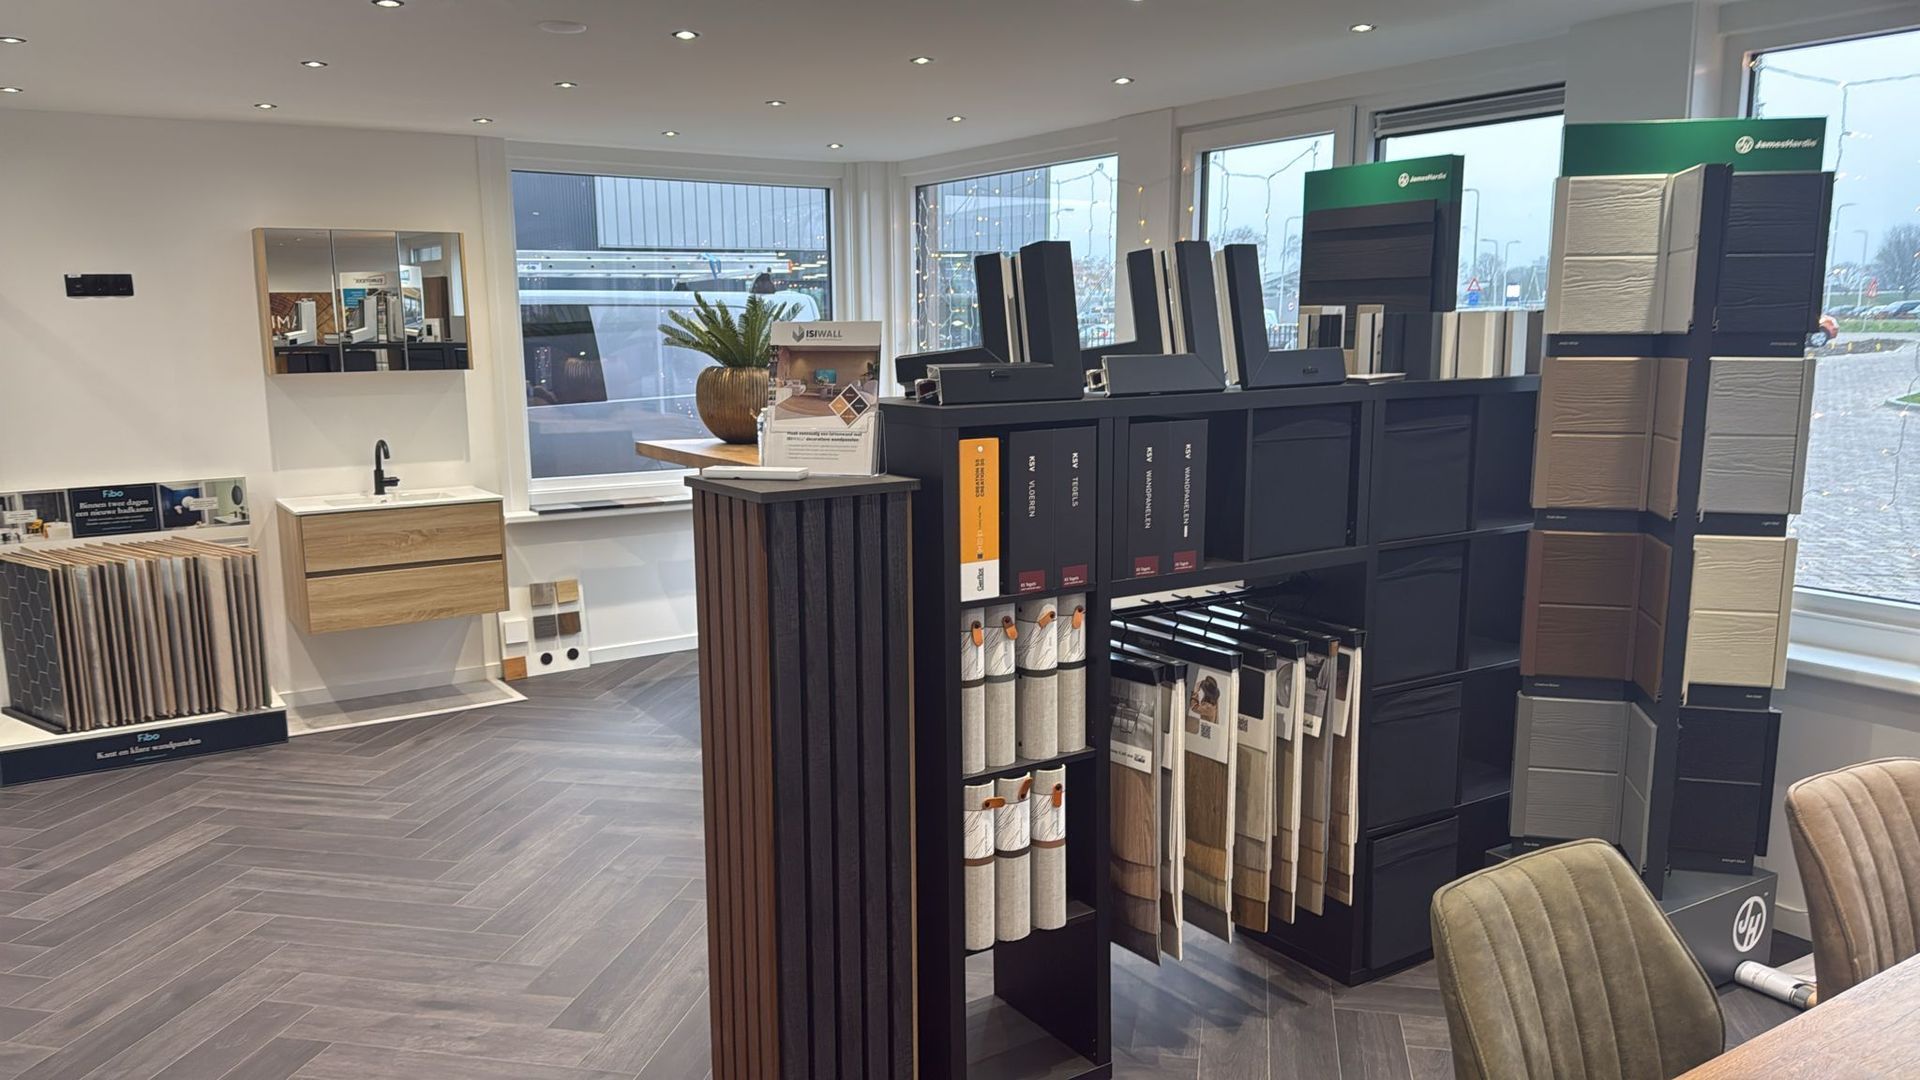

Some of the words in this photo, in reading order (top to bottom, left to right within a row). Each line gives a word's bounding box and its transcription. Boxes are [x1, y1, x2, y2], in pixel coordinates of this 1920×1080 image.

[1755, 138, 1818, 149] JamesHardie
[806, 329, 843, 338] ISIWALL
[1028, 455, 1036, 472] KSV
[102, 489, 124, 498] Fibo
[1028, 480, 1036, 518] VLOEREN
[1071, 476, 1079, 508] TEGELS
[1144, 469, 1152, 529] WANDPANELEN
[1183, 466, 1191, 525] WANDPANELEN
[137, 732, 160, 742] Fibo
